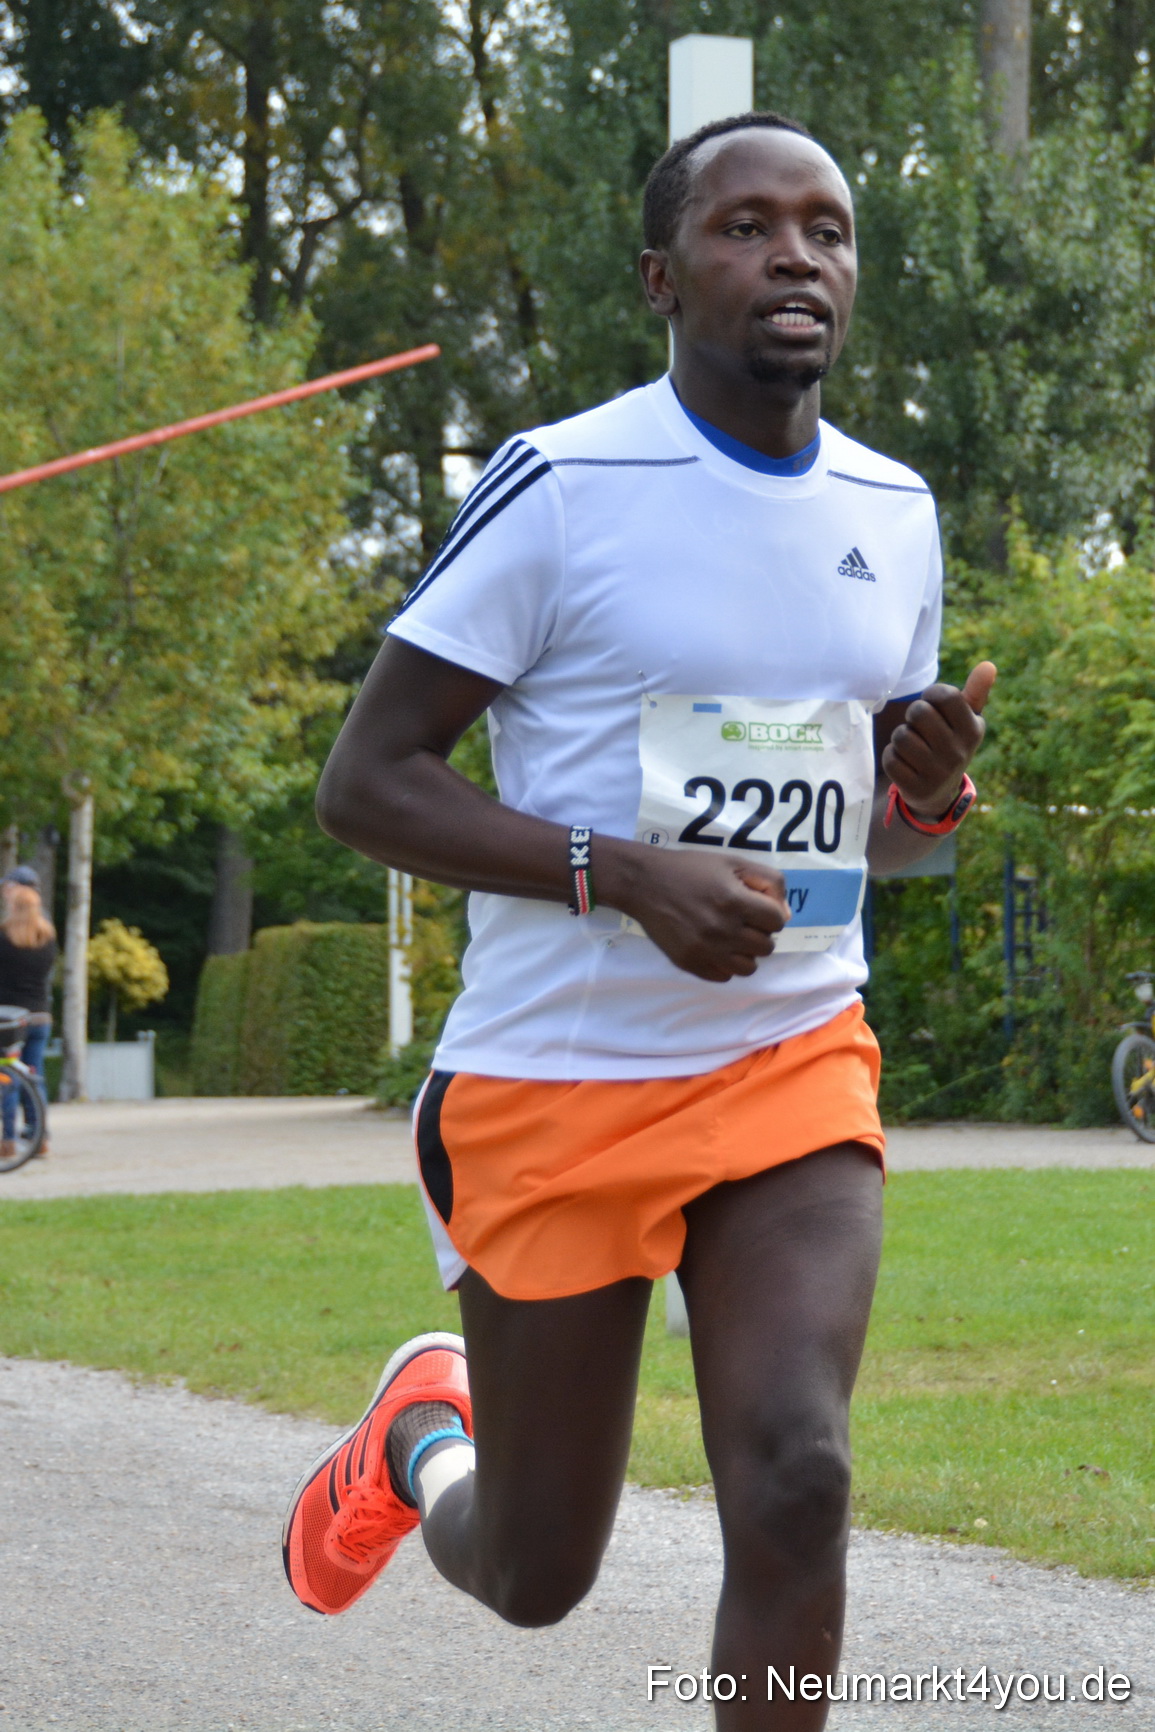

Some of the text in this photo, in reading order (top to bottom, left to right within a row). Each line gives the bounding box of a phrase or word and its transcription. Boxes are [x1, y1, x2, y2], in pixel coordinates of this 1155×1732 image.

[837, 565, 876, 582] adidas
[748, 722, 823, 743] BOCK
[678, 775, 845, 854] 2220
[650, 832, 660, 846] B
[783, 887, 810, 913] ry
